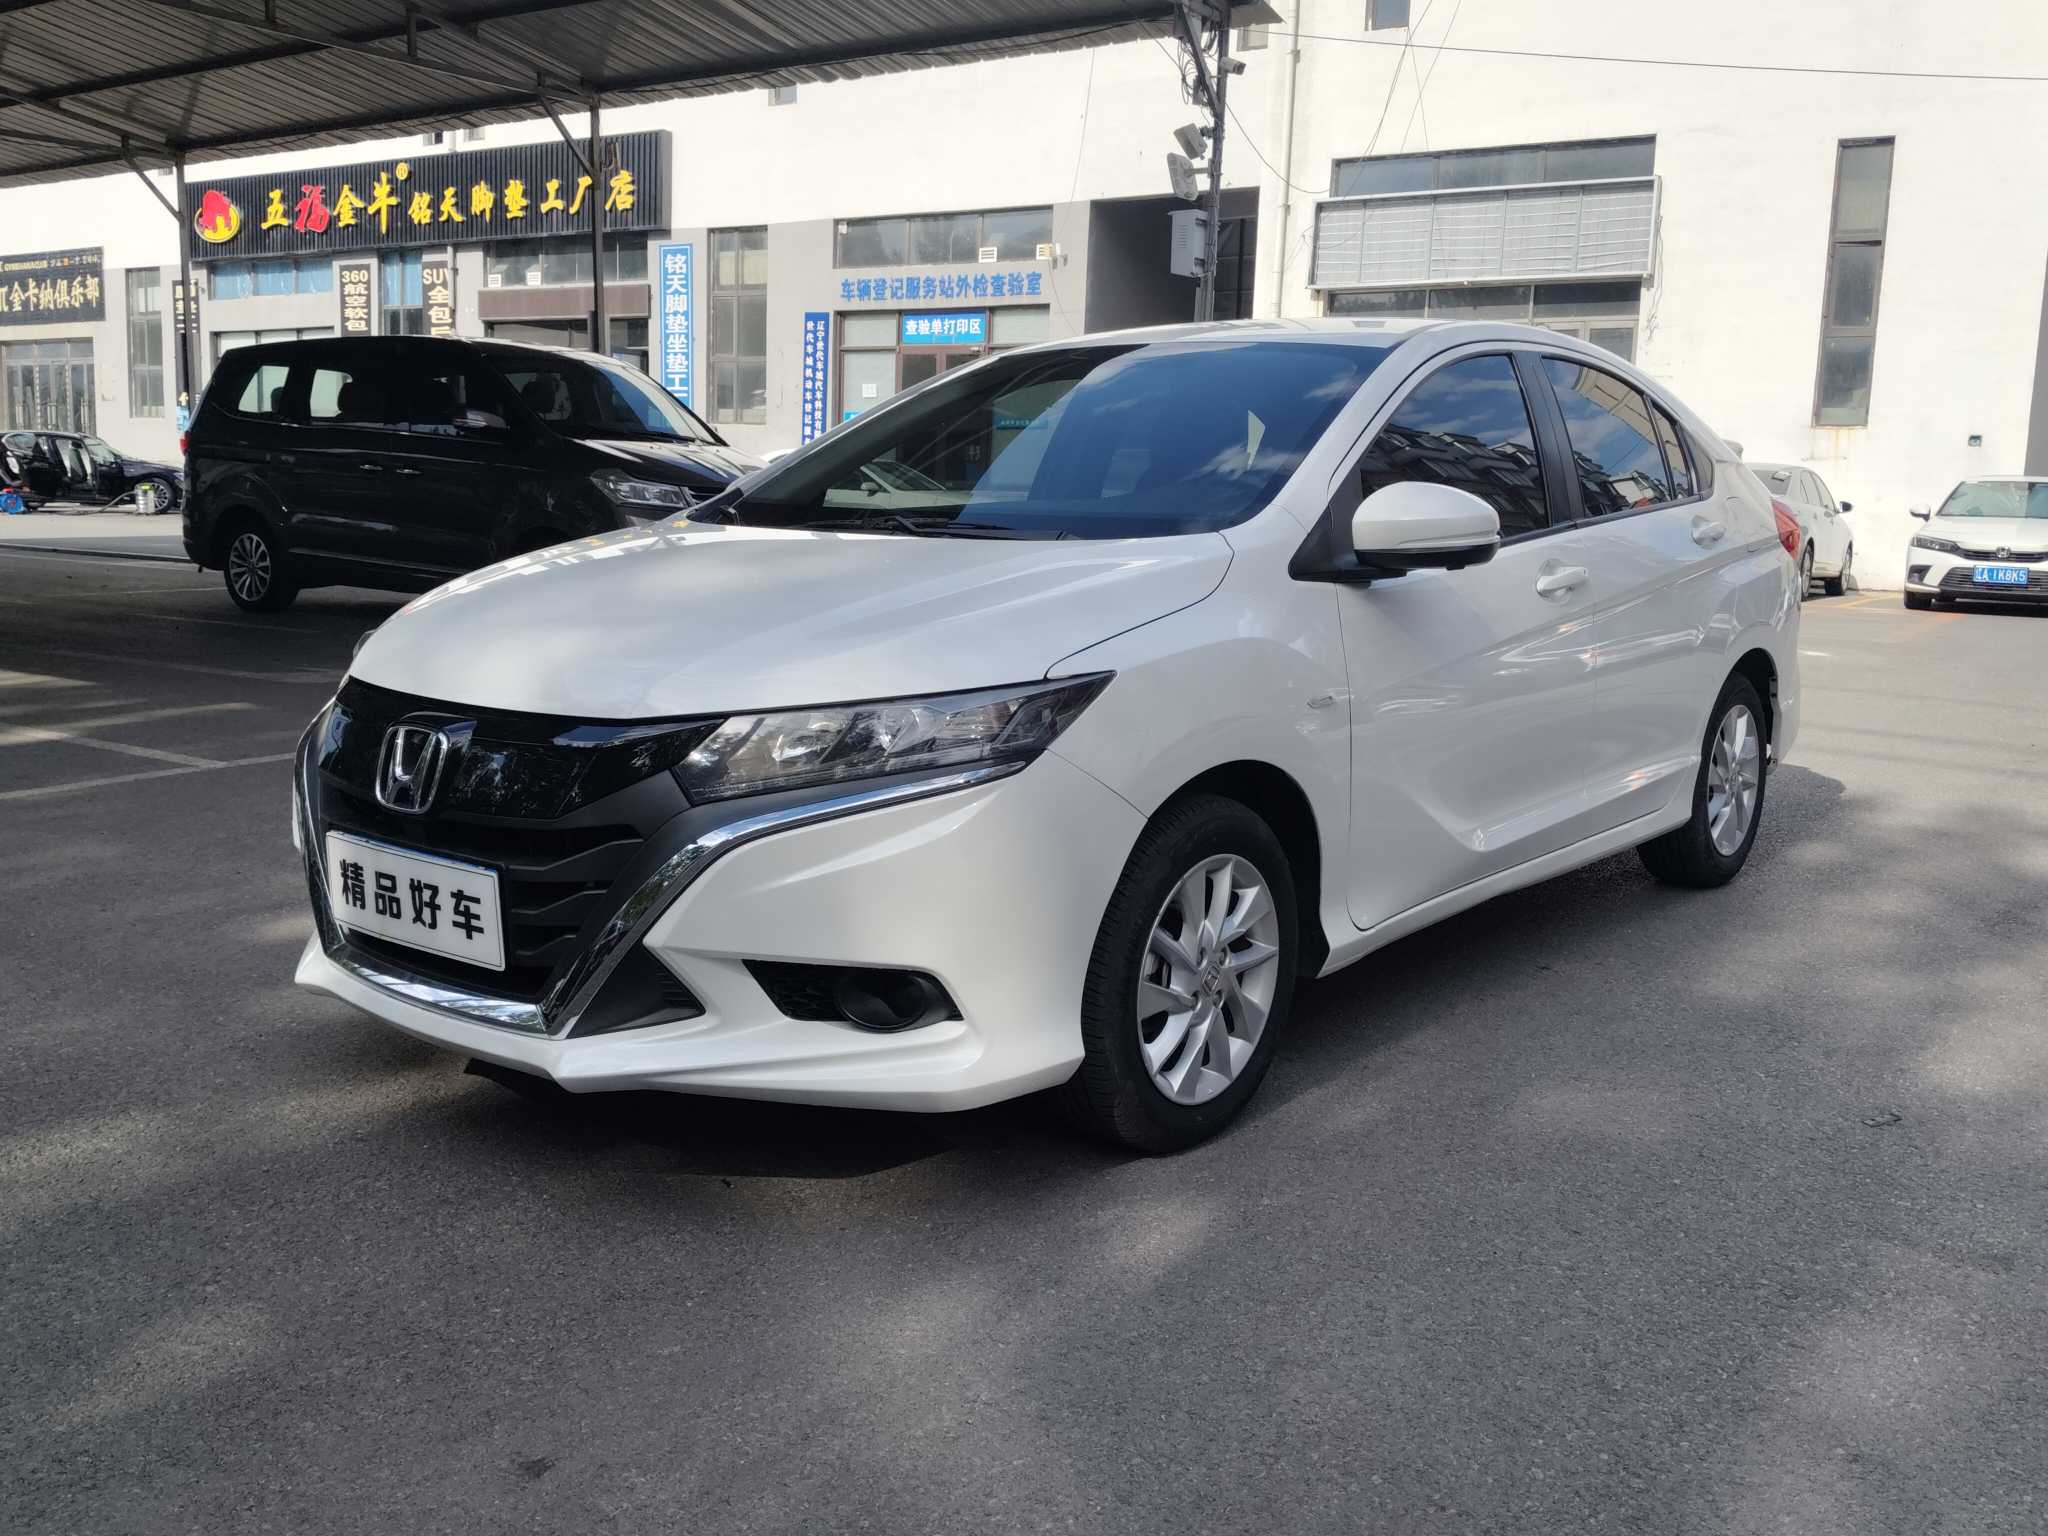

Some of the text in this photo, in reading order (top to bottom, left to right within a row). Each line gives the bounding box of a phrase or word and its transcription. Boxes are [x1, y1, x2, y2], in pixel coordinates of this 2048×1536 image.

[261, 169, 634, 234] 五福金牛 铭天脚垫工厂店
[840, 271, 1042, 302] 车辆登记服务站外检查验室
[665, 254, 688, 397] 铭天脚垫坐垫工
[905, 319, 982, 336] 查验单打印区
[339, 858, 485, 940] 精品好车
